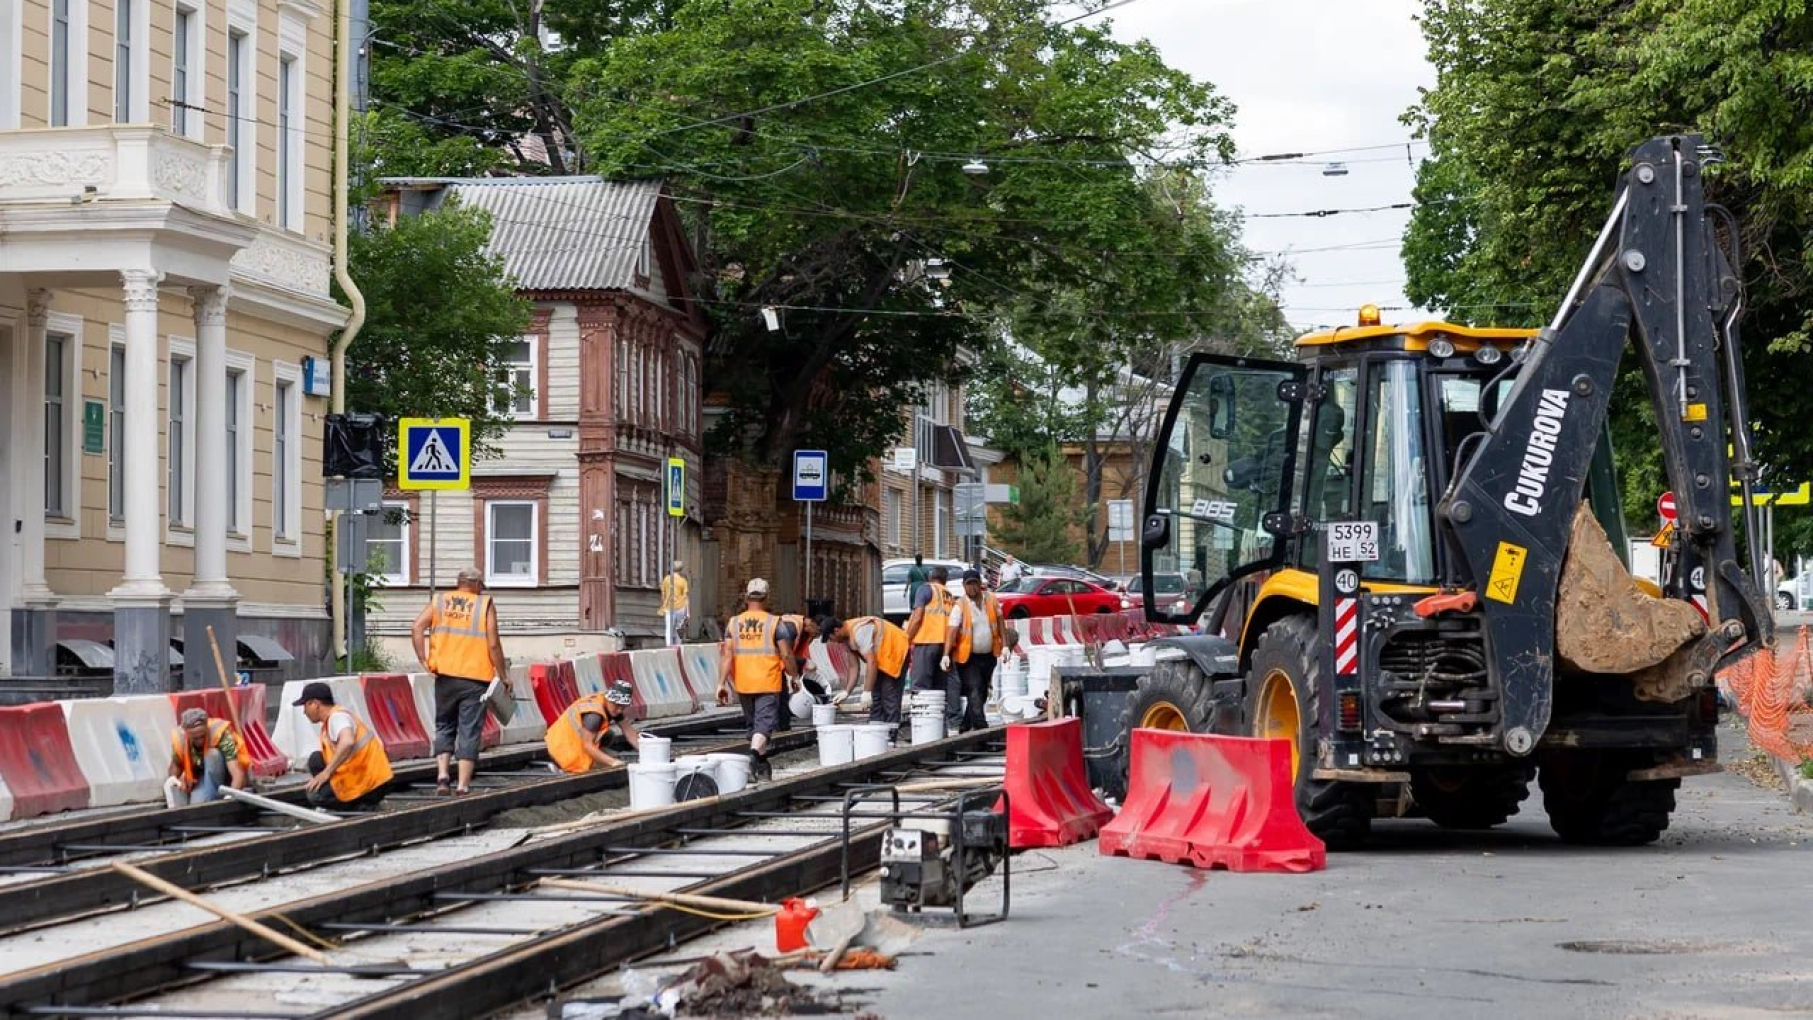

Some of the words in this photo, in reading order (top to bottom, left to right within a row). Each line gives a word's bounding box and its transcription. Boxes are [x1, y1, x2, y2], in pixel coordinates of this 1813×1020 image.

[1504, 389, 1570, 516] ÇUKUROVA
[1190, 499, 1238, 517] 885
[1335, 524, 1371, 540] 5399
[1360, 543, 1375, 554] 52
[1337, 573, 1357, 588] 40
[1692, 571, 1702, 586] 4
